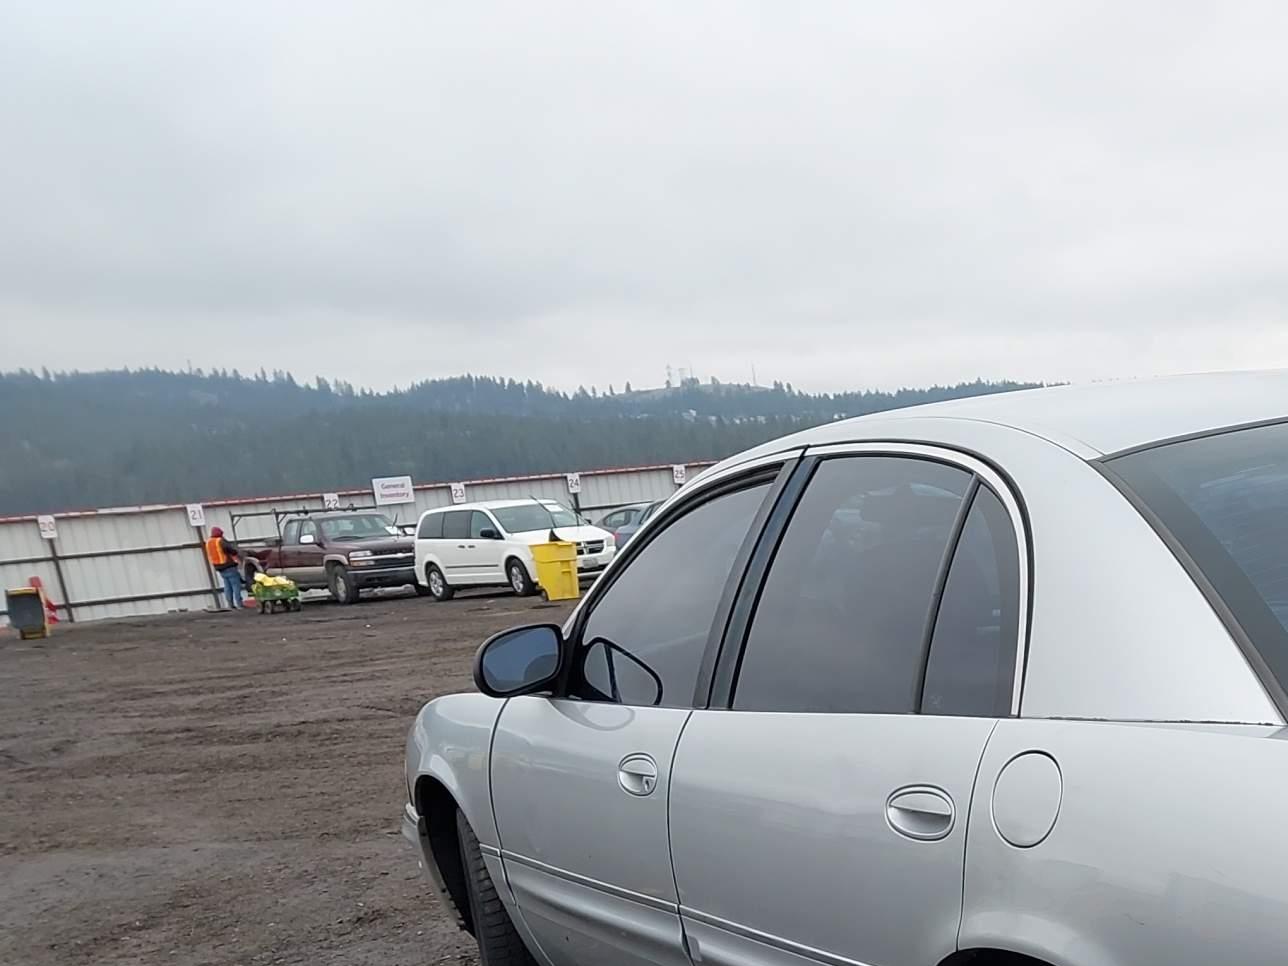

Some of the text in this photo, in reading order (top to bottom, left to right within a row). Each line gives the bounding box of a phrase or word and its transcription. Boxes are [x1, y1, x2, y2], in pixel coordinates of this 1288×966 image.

[381, 482, 405, 490] General
[568, 478, 580, 488] 24
[380, 491, 410, 499] Inventory
[453, 488, 465, 498] 23
[190, 509, 203, 520] 21
